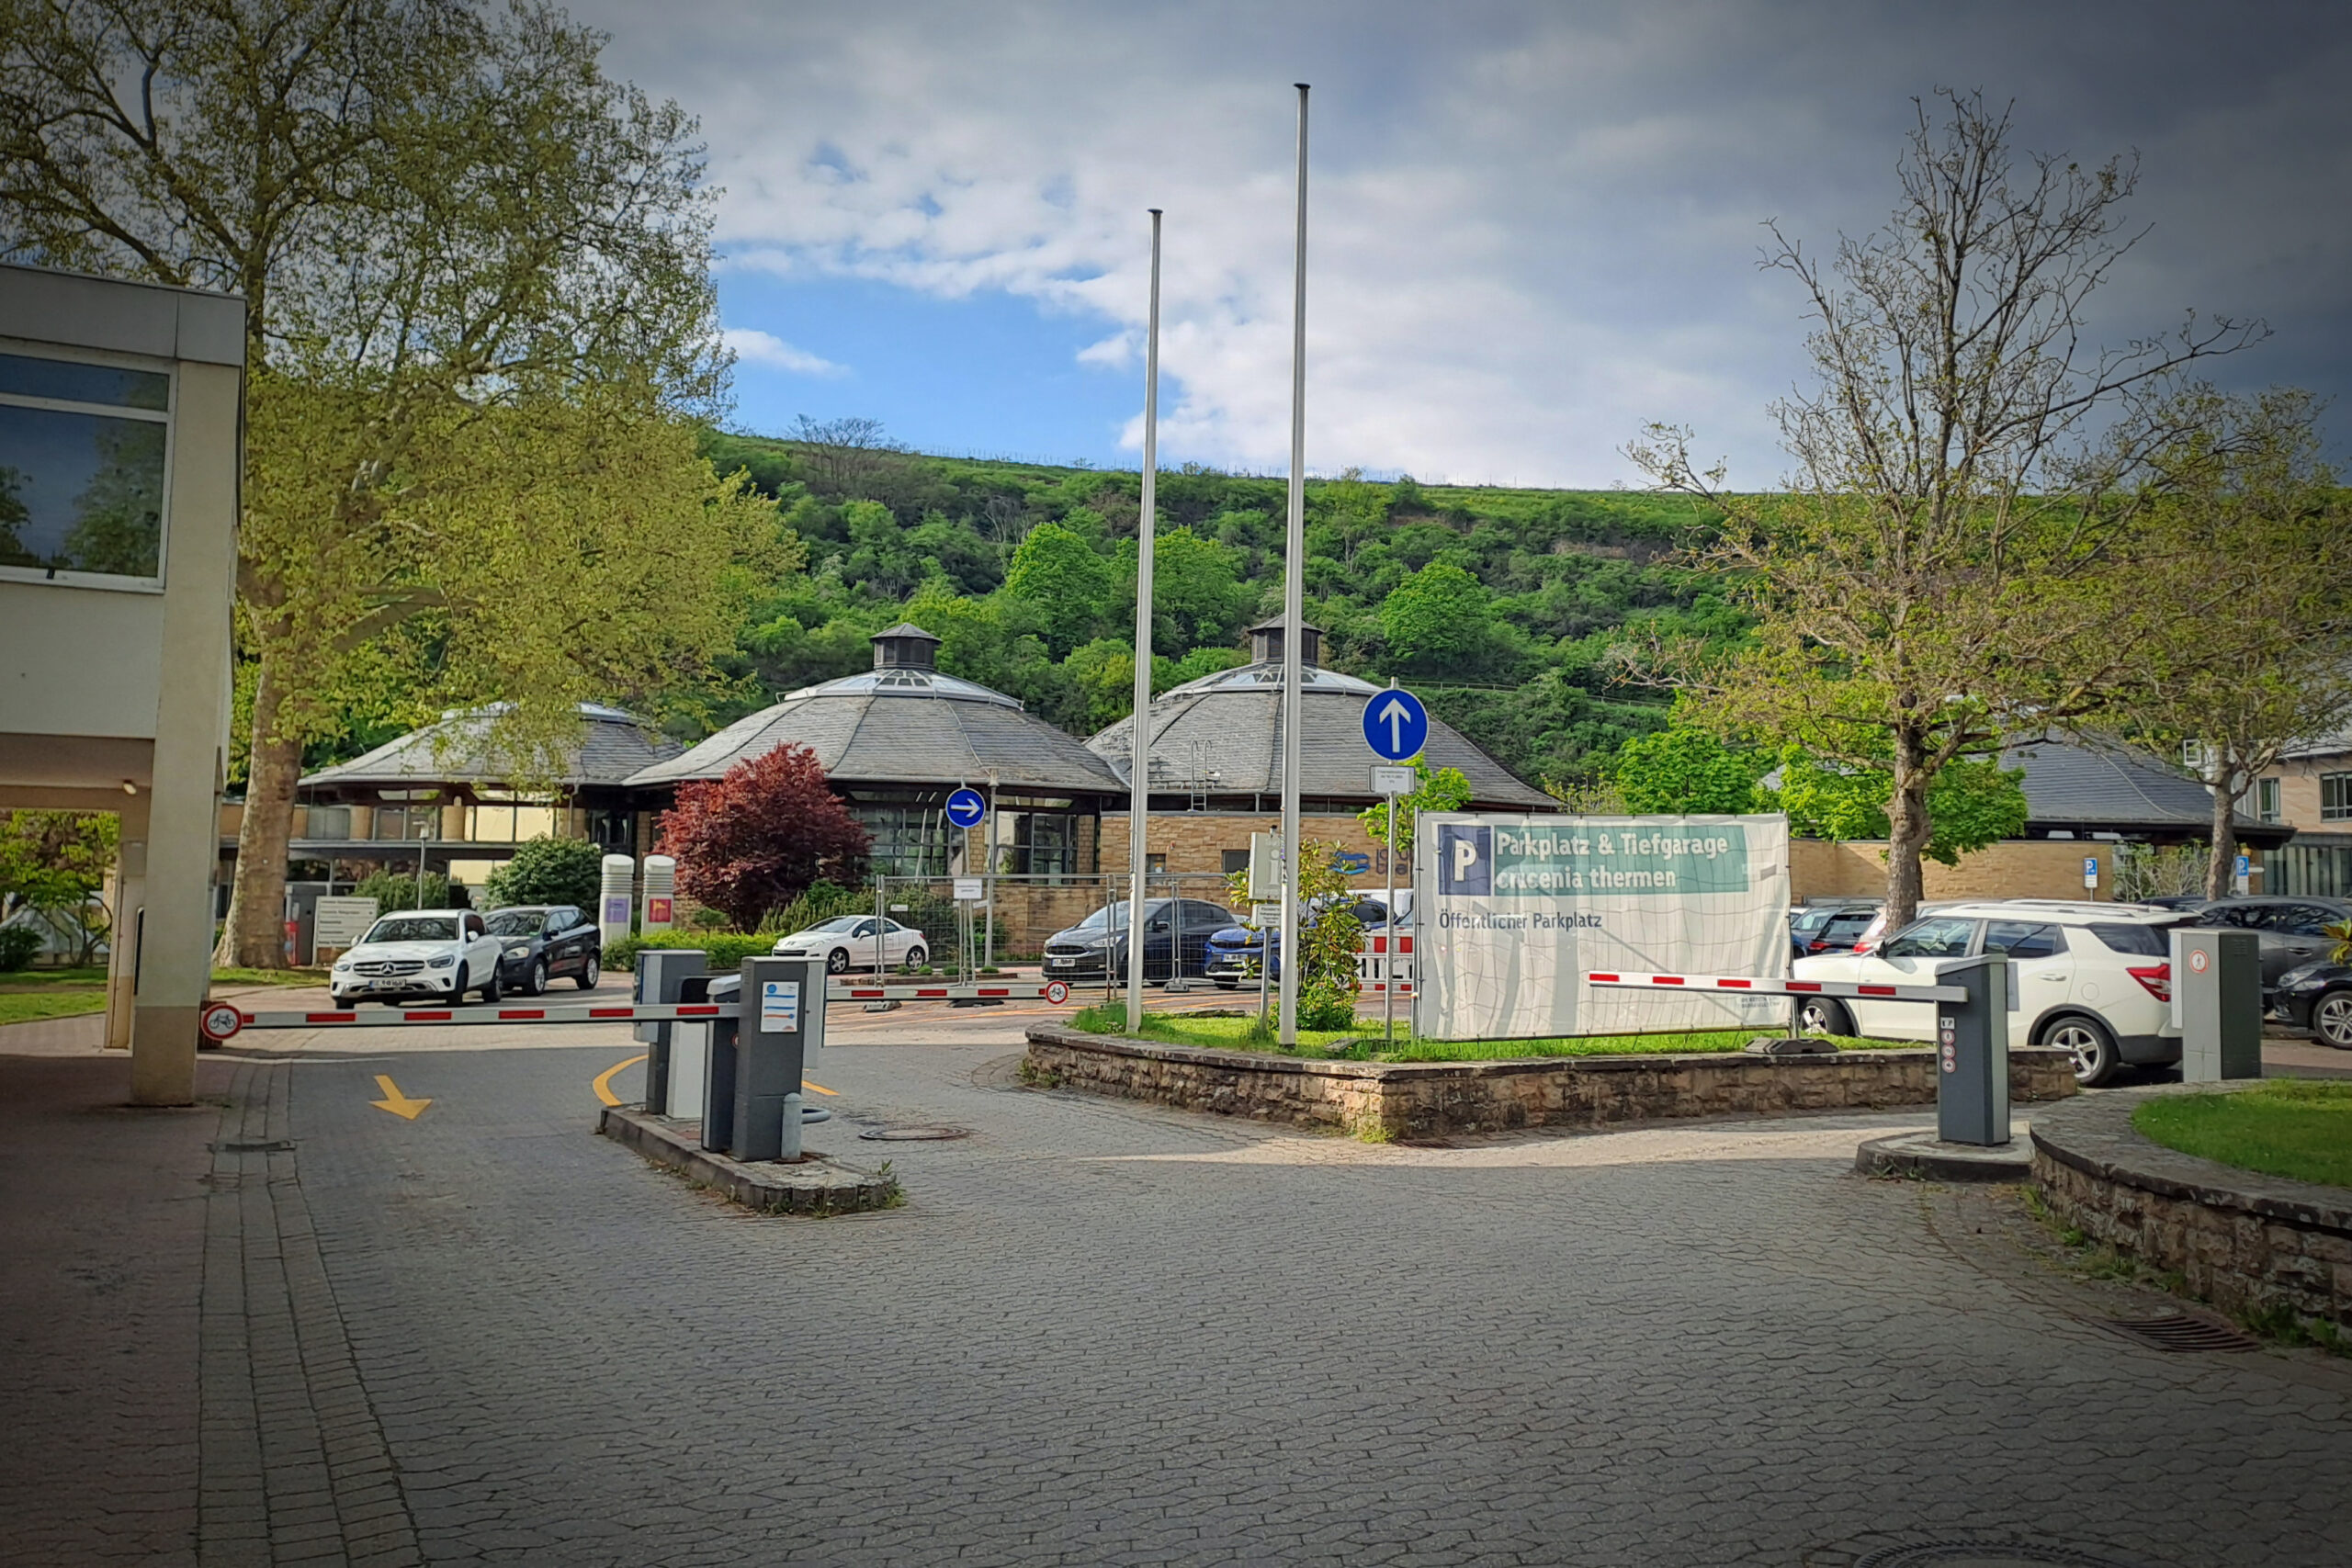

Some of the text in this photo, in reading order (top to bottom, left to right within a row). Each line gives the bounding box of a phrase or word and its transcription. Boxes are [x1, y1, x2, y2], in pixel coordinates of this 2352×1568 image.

[1496, 832, 1729, 861] Parkplatz & Tiefgarage
[1454, 839, 1477, 882] P
[1496, 864, 1677, 889] crucenia thermen
[1439, 908, 1602, 931] Öffentlicher Parkplatz
